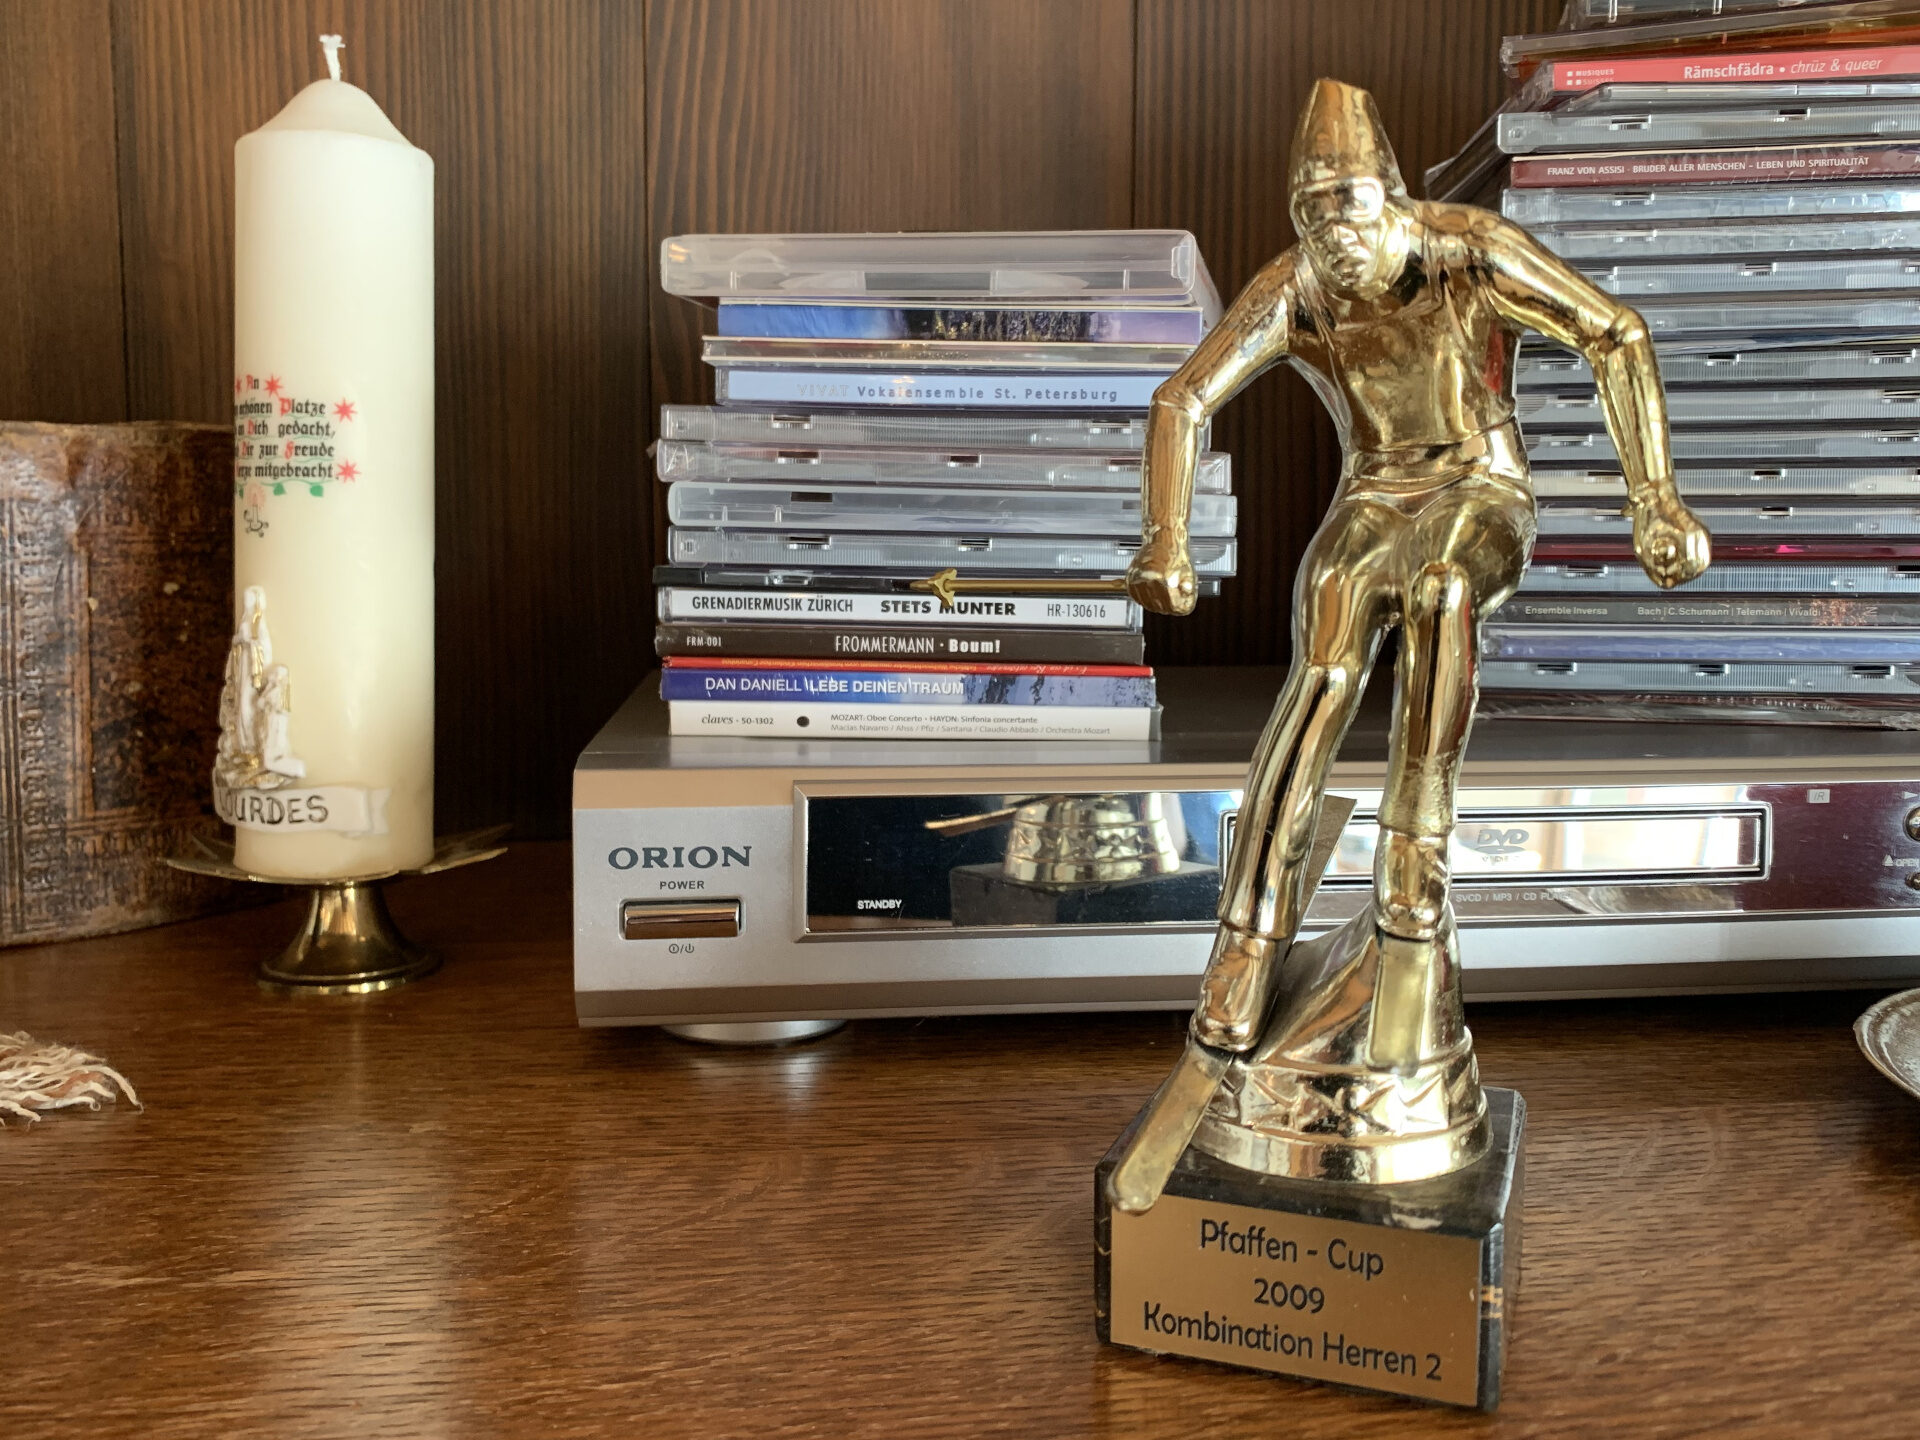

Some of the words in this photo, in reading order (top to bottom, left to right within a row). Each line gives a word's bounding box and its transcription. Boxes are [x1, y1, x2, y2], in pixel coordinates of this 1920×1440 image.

[1684, 63, 1774, 79] Rämschfädra
[1830, 59, 1841, 72] &
[1845, 58, 1882, 74] queer
[1547, 167, 1574, 175] FRANZ
[1578, 167, 1595, 175] VON
[1598, 166, 1625, 174] ASSISI
[1669, 163, 1695, 172] ALLER
[1697, 162, 1746, 171] MENSCHEN
[1756, 160, 1784, 169] LEBEN
[1786, 159, 1806, 168] UND
[1808, 156, 1869, 167] SPIRITUALITÄT
[797, 384, 848, 396] VIVAT
[857, 385, 985, 399] Vokalensemble
[994, 387, 1017, 399] St.
[1025, 388, 1118, 402] Petersburg
[279, 397, 326, 417] Platze
[278, 420, 335, 438] gedacht,
[259, 444, 278, 459] zur
[284, 441, 334, 459] Freude
[692, 596, 803, 611] GRENADIERMUSIK
[807, 595, 853, 612] ZÜRICH
[881, 600, 932, 614] STETS
[1047, 604, 1106, 618] HR-130616
[1525, 606, 1571, 615] Ensemble
[1573, 606, 1608, 615] Inversa
[1637, 607, 1661, 616] Bach
[1736, 607, 1782, 617] Telemann
[687, 636, 722, 646] FRM-001
[835, 635, 934, 653] FROMMERMANN
[949, 638, 1001, 654] Boum!
[705, 677, 736, 692] DAN
[741, 677, 802, 692] DANIELL
[810, 679, 848, 693] LEBE
[853, 680, 908, 694] DEINEN
[911, 682, 964, 695] TRAUM
[702, 714, 733, 724] claves
[741, 717, 774, 725] 50-1302
[866, 714, 886, 722] Oboe
[859, 724, 889, 732] Navarro
[979, 725, 1008, 733] Claudio
[1009, 726, 1039, 734] Abbado
[1045, 726, 1082, 735] Orchestra
[1083, 727, 1111, 735] Mozart
[1477, 829, 1530, 847] DVD
[608, 846, 752, 870] ORION
[659, 880, 705, 890] POWER
[857, 899, 902, 910] STANDBY
[1456, 893, 1482, 902] SVCD
[1493, 893, 1512, 901] MP3
[1523, 892, 1537, 901] CD
[1201, 1218, 1298, 1263] Pfaffen
[1328, 1238, 1384, 1280] Cup
[1253, 1278, 1325, 1314] 2009
[1144, 1301, 1313, 1359] Kombination
[1323, 1332, 1416, 1377] Herren
[1425, 1353, 1442, 1381] 2
